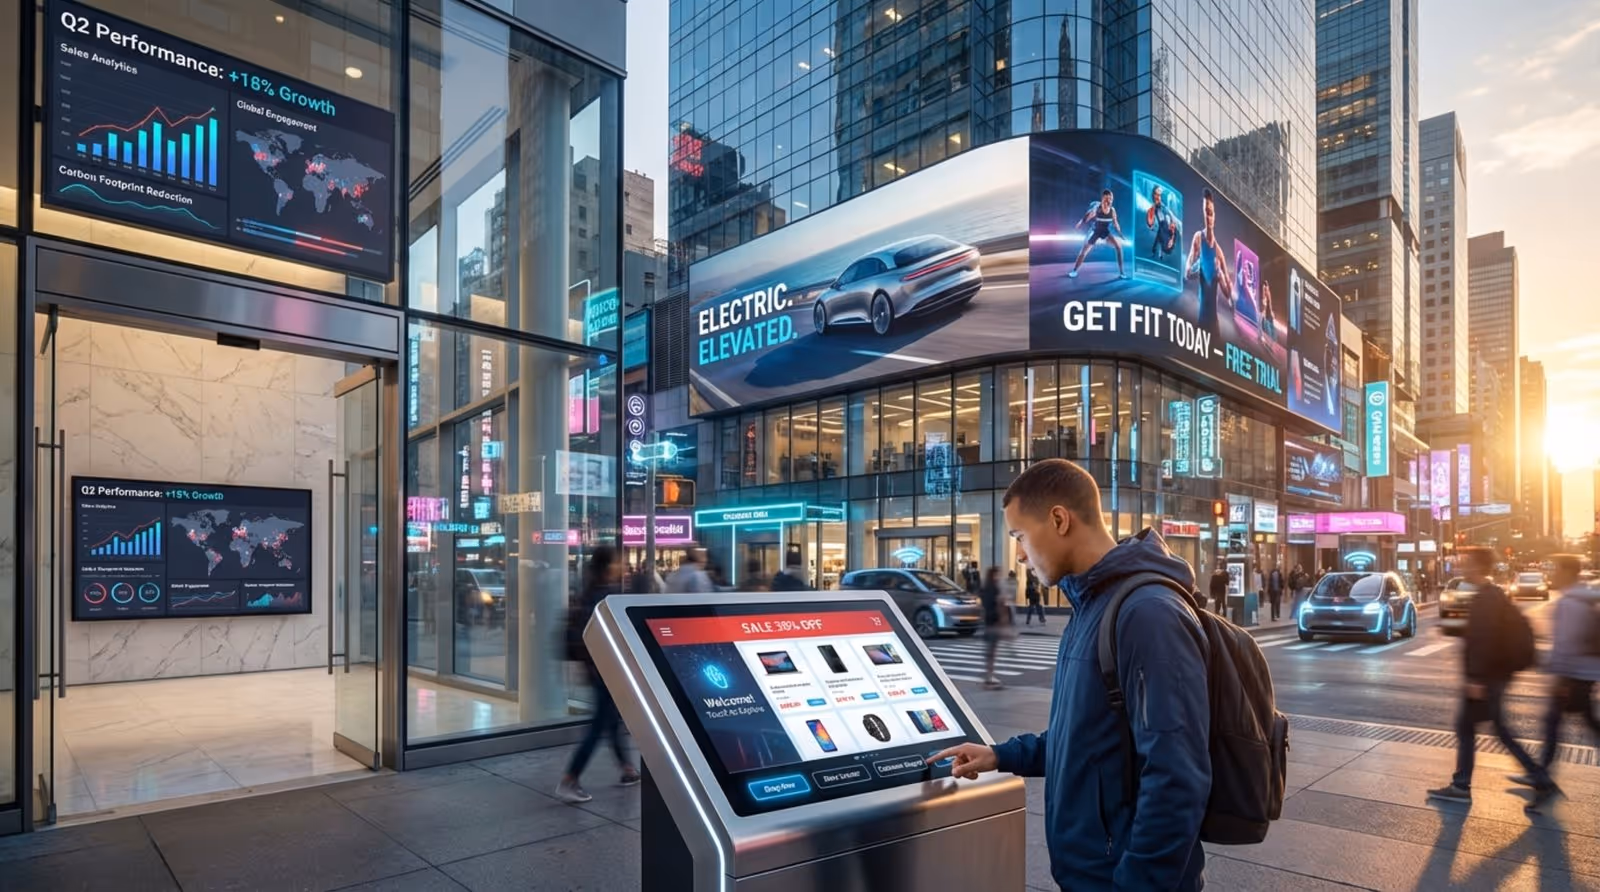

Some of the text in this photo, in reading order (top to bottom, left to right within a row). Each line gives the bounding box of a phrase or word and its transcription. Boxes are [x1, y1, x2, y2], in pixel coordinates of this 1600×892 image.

[60, 43, 89, 59] Sales
[61, 12, 90, 34] Q2
[96, 22, 224, 79] Performance:
[279, 86, 336, 116] Growth
[698, 283, 793, 336] ELECTRIC.
[698, 314, 798, 366] ELEVATED.
[1063, 301, 1122, 332] GET
[1130, 303, 1163, 338] FIT
[1167, 312, 1211, 359] TODAY
[1225, 342, 1253, 380] FREE
[1254, 357, 1282, 394] TRIAL
[81, 486, 96, 496] Q2
[98, 487, 164, 498] Performance:
[741, 622, 773, 634] SALE
[703, 693, 756, 708] Welcome!
